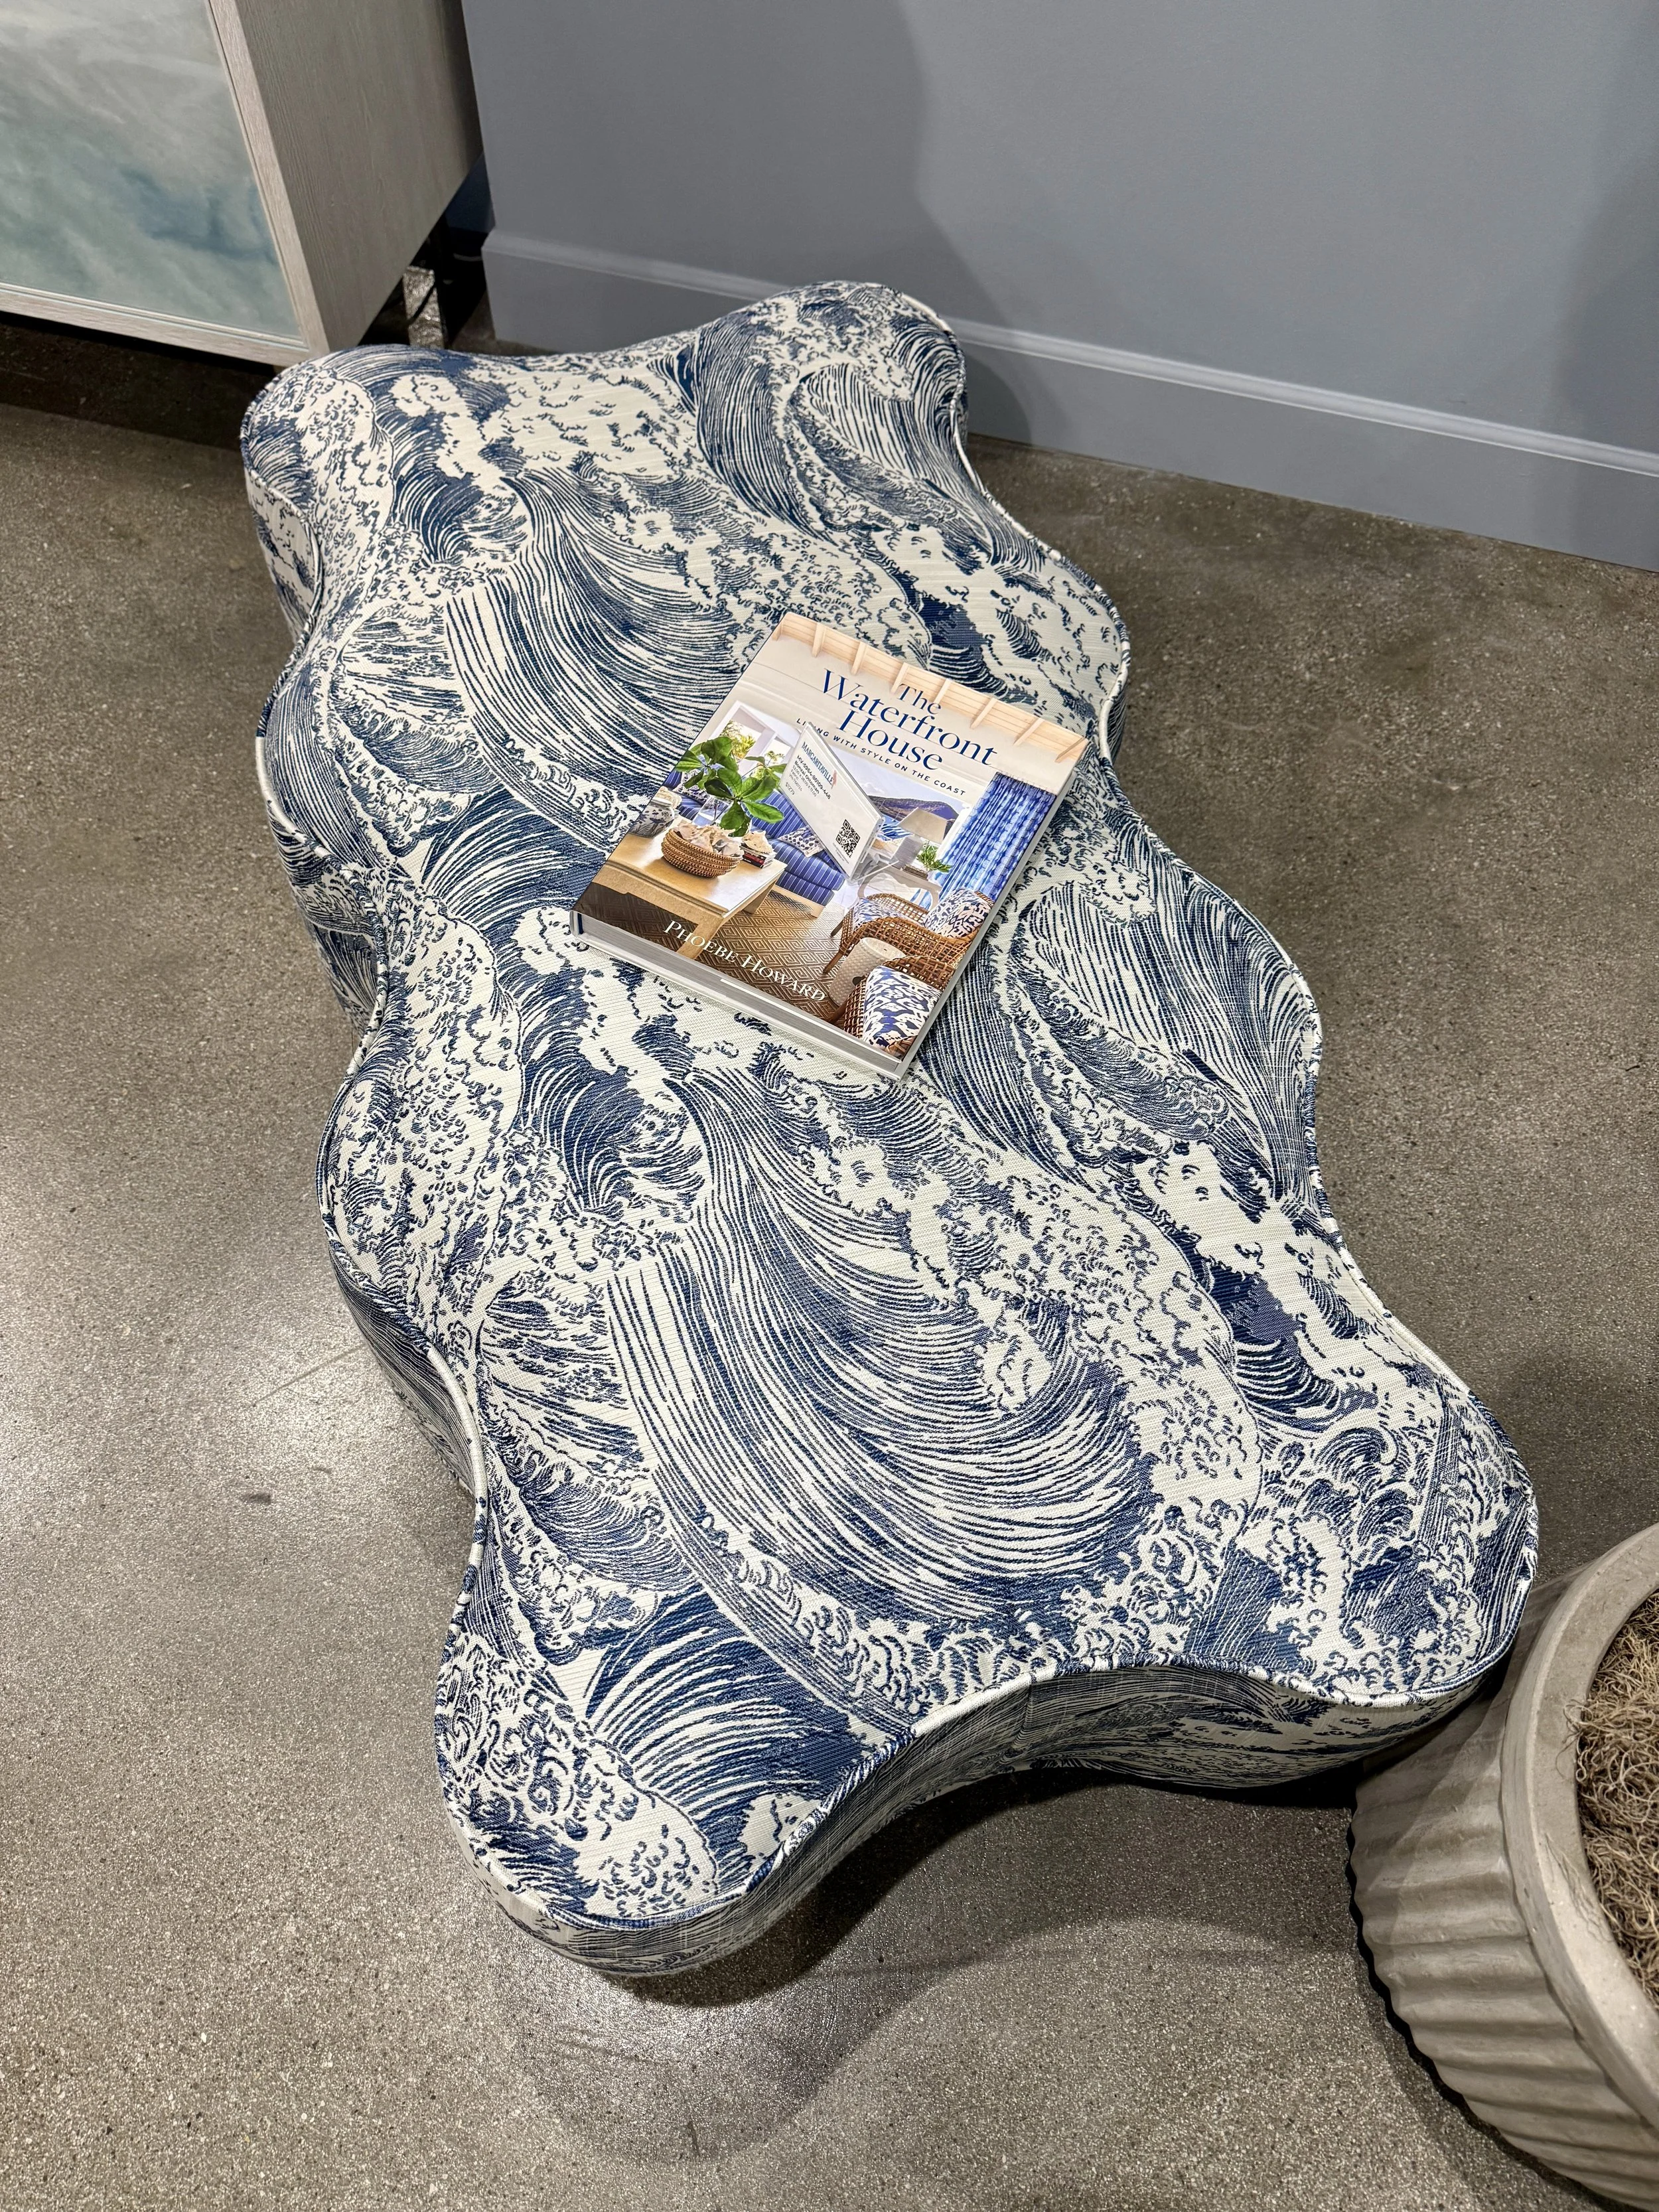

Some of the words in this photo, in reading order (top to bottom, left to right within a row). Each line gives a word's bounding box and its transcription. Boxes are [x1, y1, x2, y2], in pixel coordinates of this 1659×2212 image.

[824, 668, 998, 766] Waterfront
[897, 684, 942, 715] The
[796, 718, 830, 737] LING
[833, 735, 857, 749] WITH
[860, 748, 891, 765] STYLE
[895, 763, 908, 772] ON
[912, 770, 930, 781] THE
[934, 780, 966, 796] COAST
[802, 741, 833, 786] MARGARITAVILLE
[836, 709, 943, 771] House
[805, 774, 820, 794] Ottoman
[662, 921, 737, 963] PHOEBE
[741, 954, 826, 1001] HOWARD
